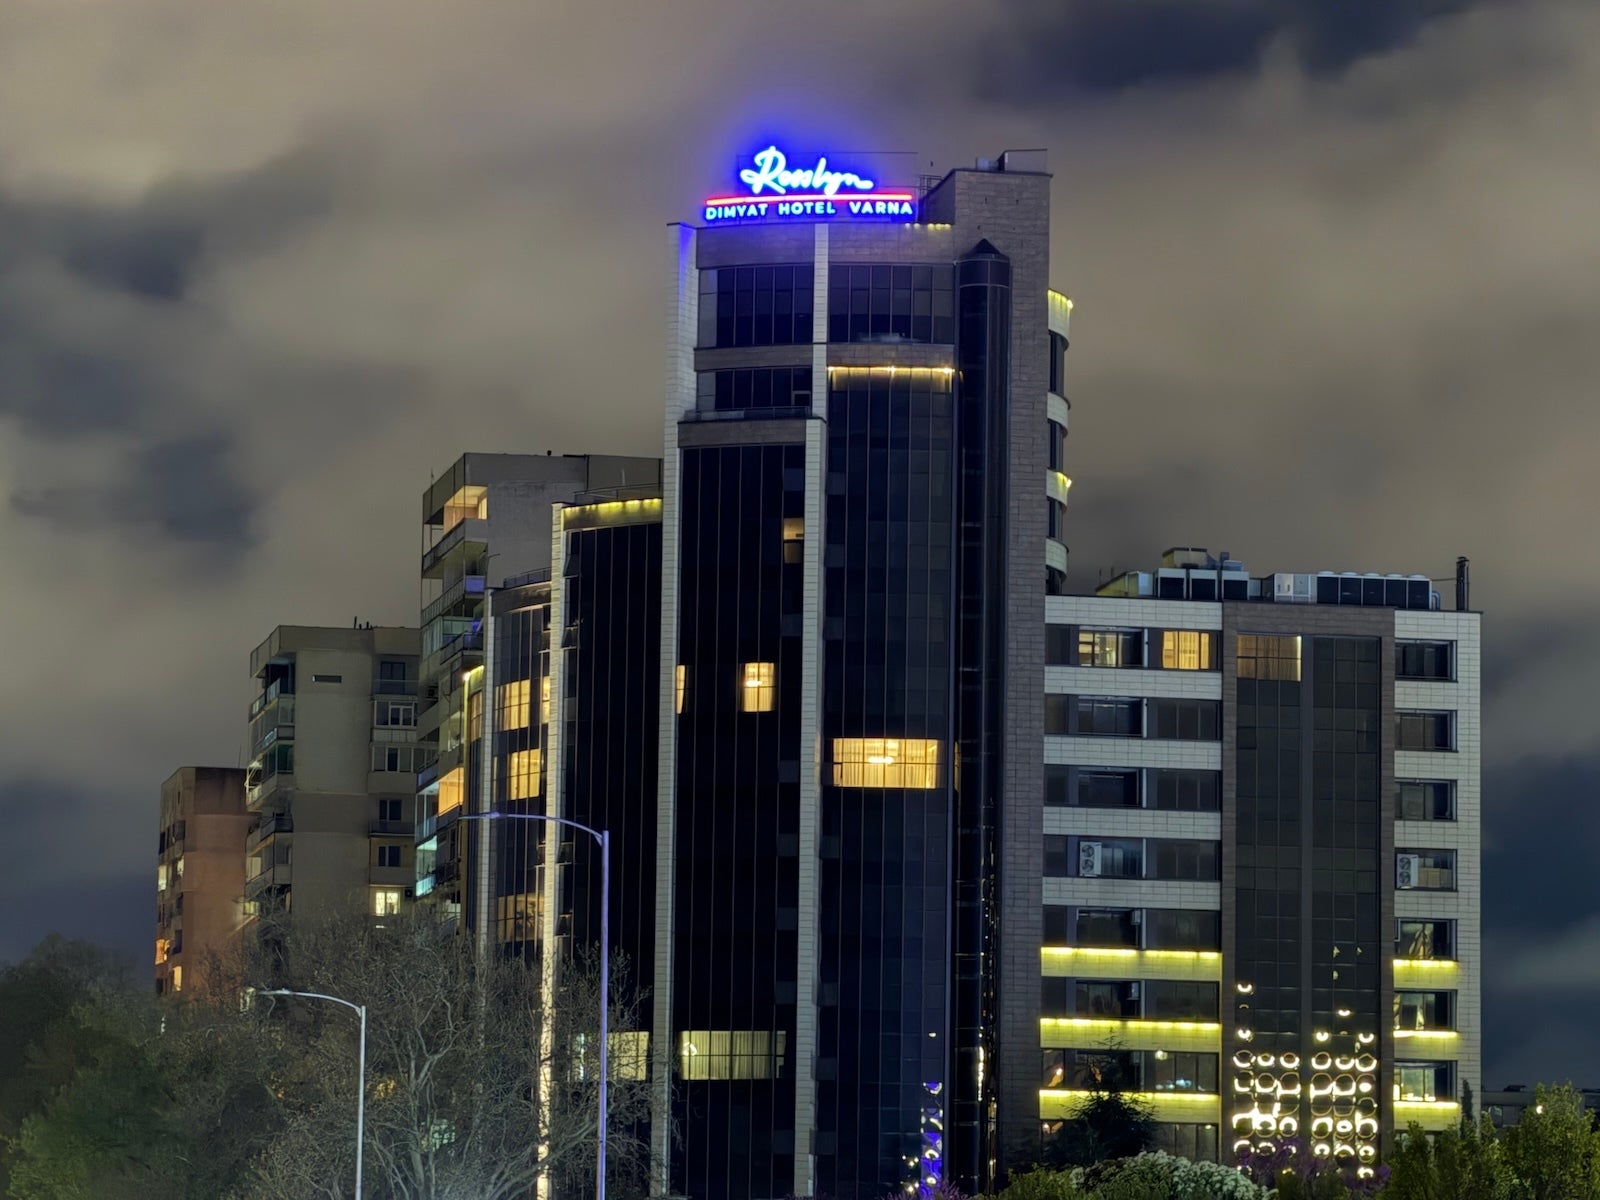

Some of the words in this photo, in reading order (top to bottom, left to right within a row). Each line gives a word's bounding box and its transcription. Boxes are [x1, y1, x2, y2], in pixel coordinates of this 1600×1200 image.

[705, 203, 768, 220] DIMYAT
[778, 202, 836, 215] HOTEL
[849, 201, 913, 215] VARNA
